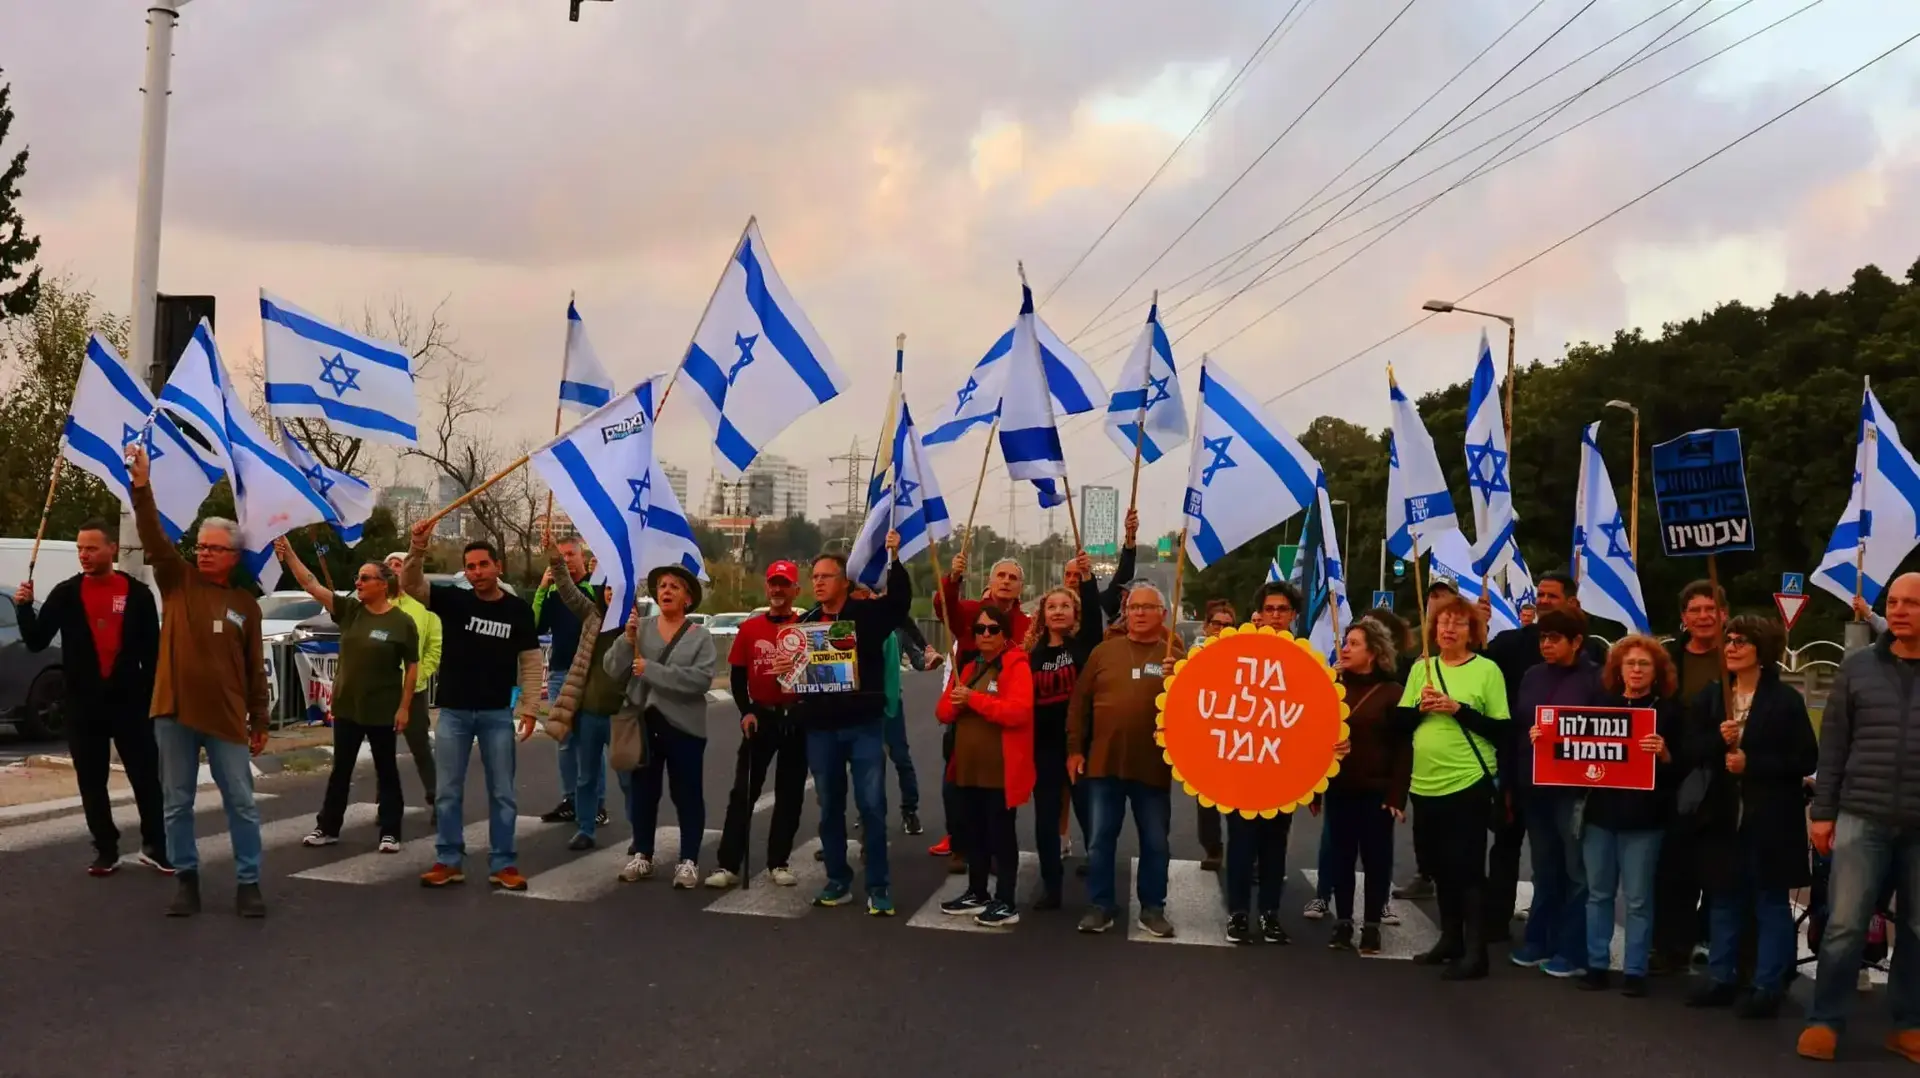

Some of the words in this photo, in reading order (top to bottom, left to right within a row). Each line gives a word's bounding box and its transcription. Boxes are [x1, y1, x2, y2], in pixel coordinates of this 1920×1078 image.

[1668, 518, 1747, 550] עכשיו!
[1235, 656, 1287, 691] מה
[1198, 686, 1304, 729] שגלנט
[1558, 714, 1587, 736] להן
[1590, 717, 1628, 737] נגמר
[1210, 728, 1281, 764] אמר
[1563, 737, 1623, 760] הזמן!
